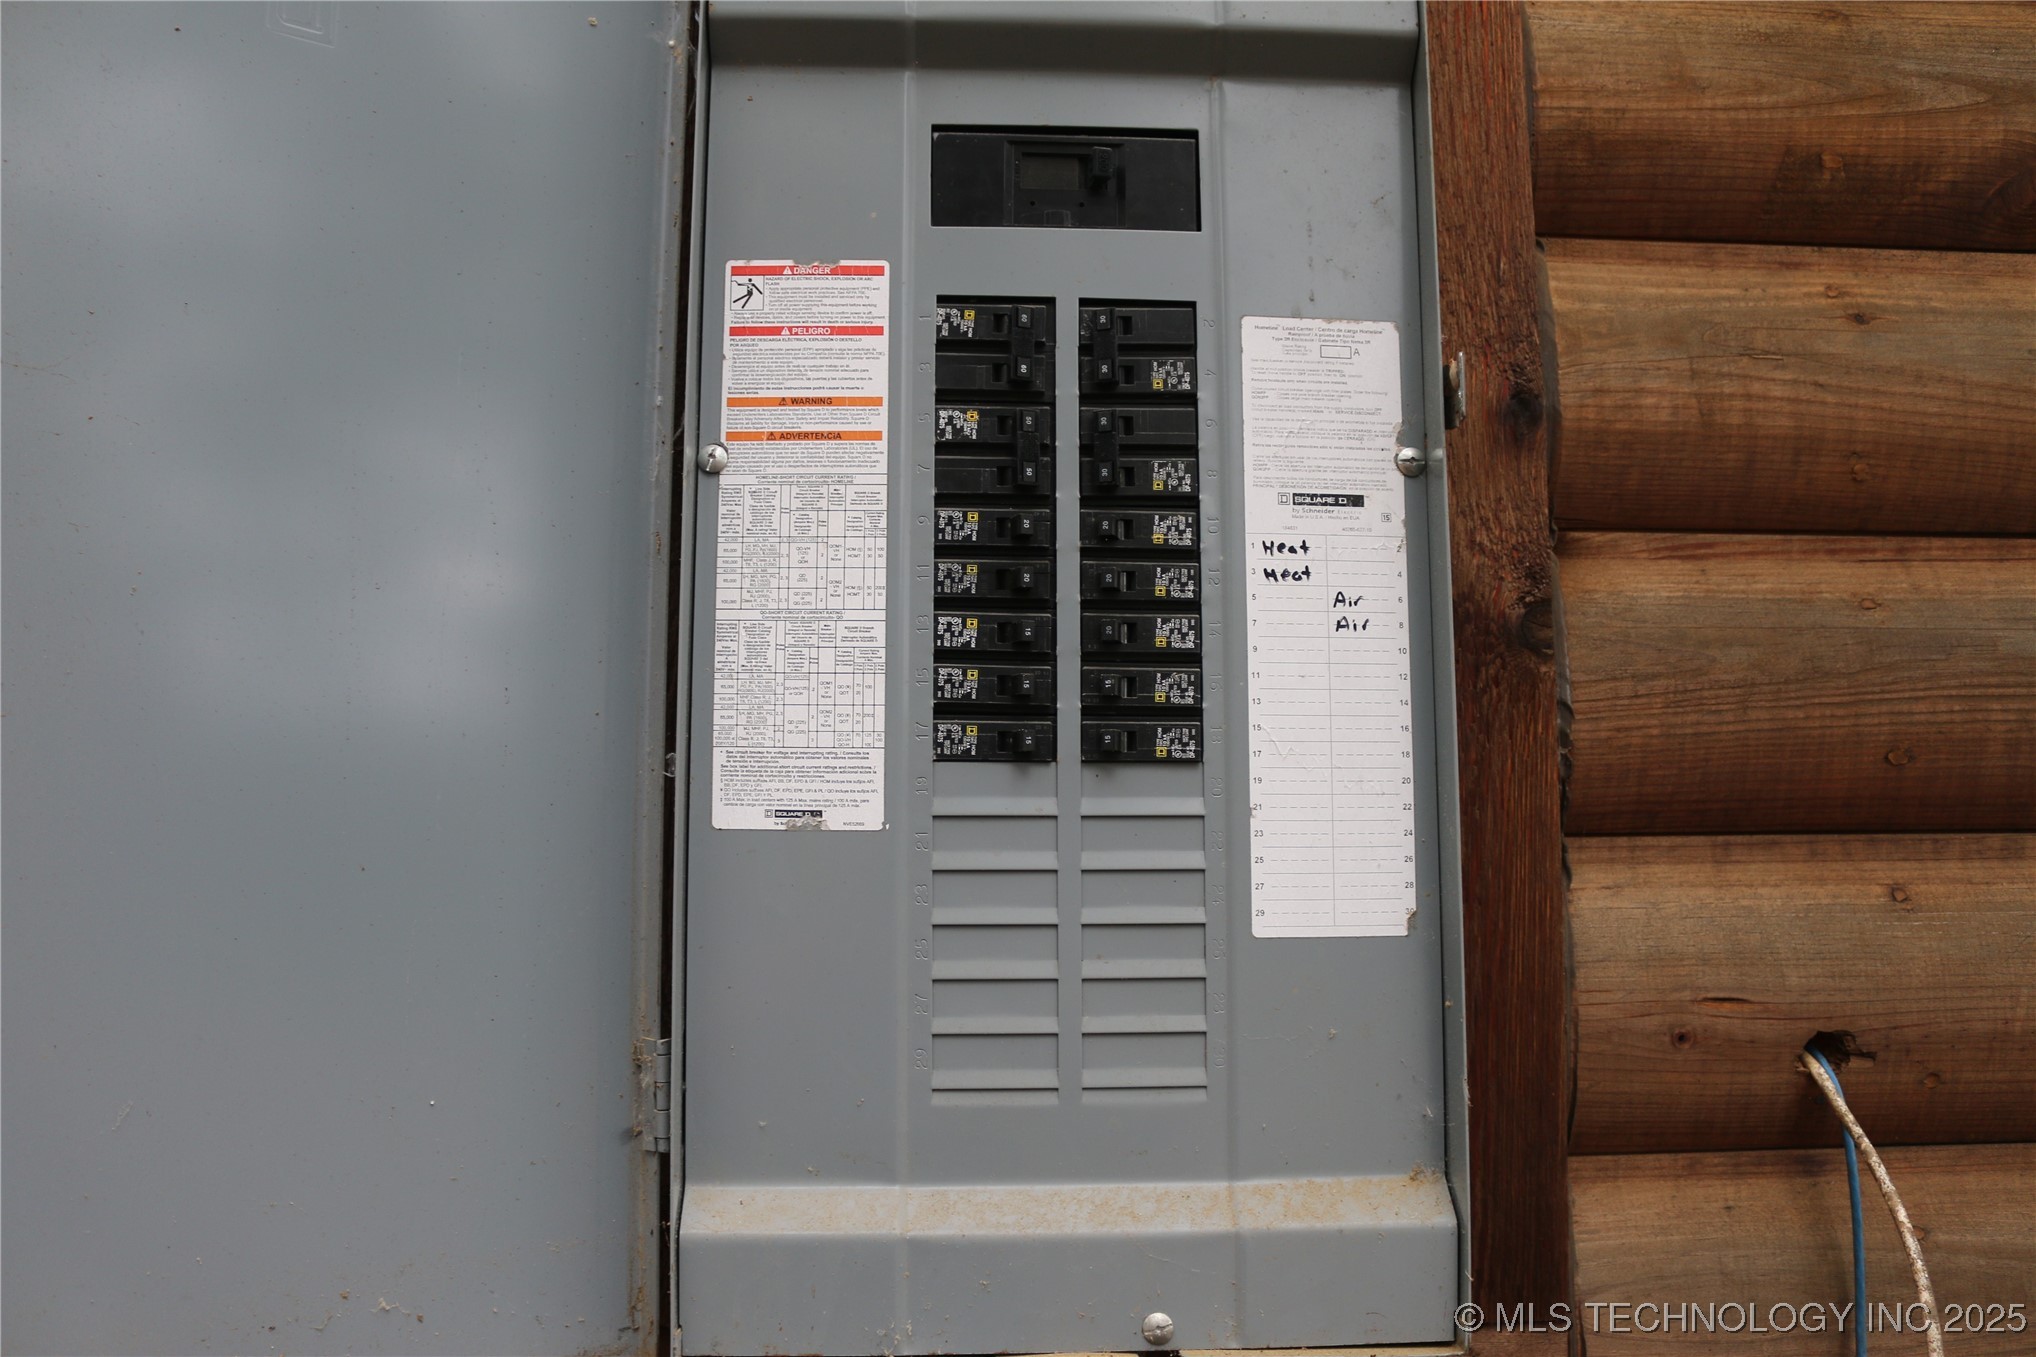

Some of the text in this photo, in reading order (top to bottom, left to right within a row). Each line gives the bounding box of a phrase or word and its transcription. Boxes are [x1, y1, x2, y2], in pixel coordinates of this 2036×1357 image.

[794, 266, 831, 274] DANGER
[1353, 348, 1360, 356] A
[1102, 365, 1108, 373] 30
[1026, 468, 1032, 476] 50
[1102, 468, 1108, 476] 30
[1024, 520, 1029, 528] 20
[1102, 521, 1109, 529] 20
[1262, 539, 1310, 556] Heat
[1263, 565, 1312, 582] Heat
[1024, 574, 1030, 582] 20
[1106, 574, 1112, 582] 20
[1333, 591, 1364, 608] Air
[1336, 616, 1369, 632] Air
[1106, 625, 1112, 634] 20
[1024, 680, 1029, 688] 15
[1105, 735, 1110, 743] 15
